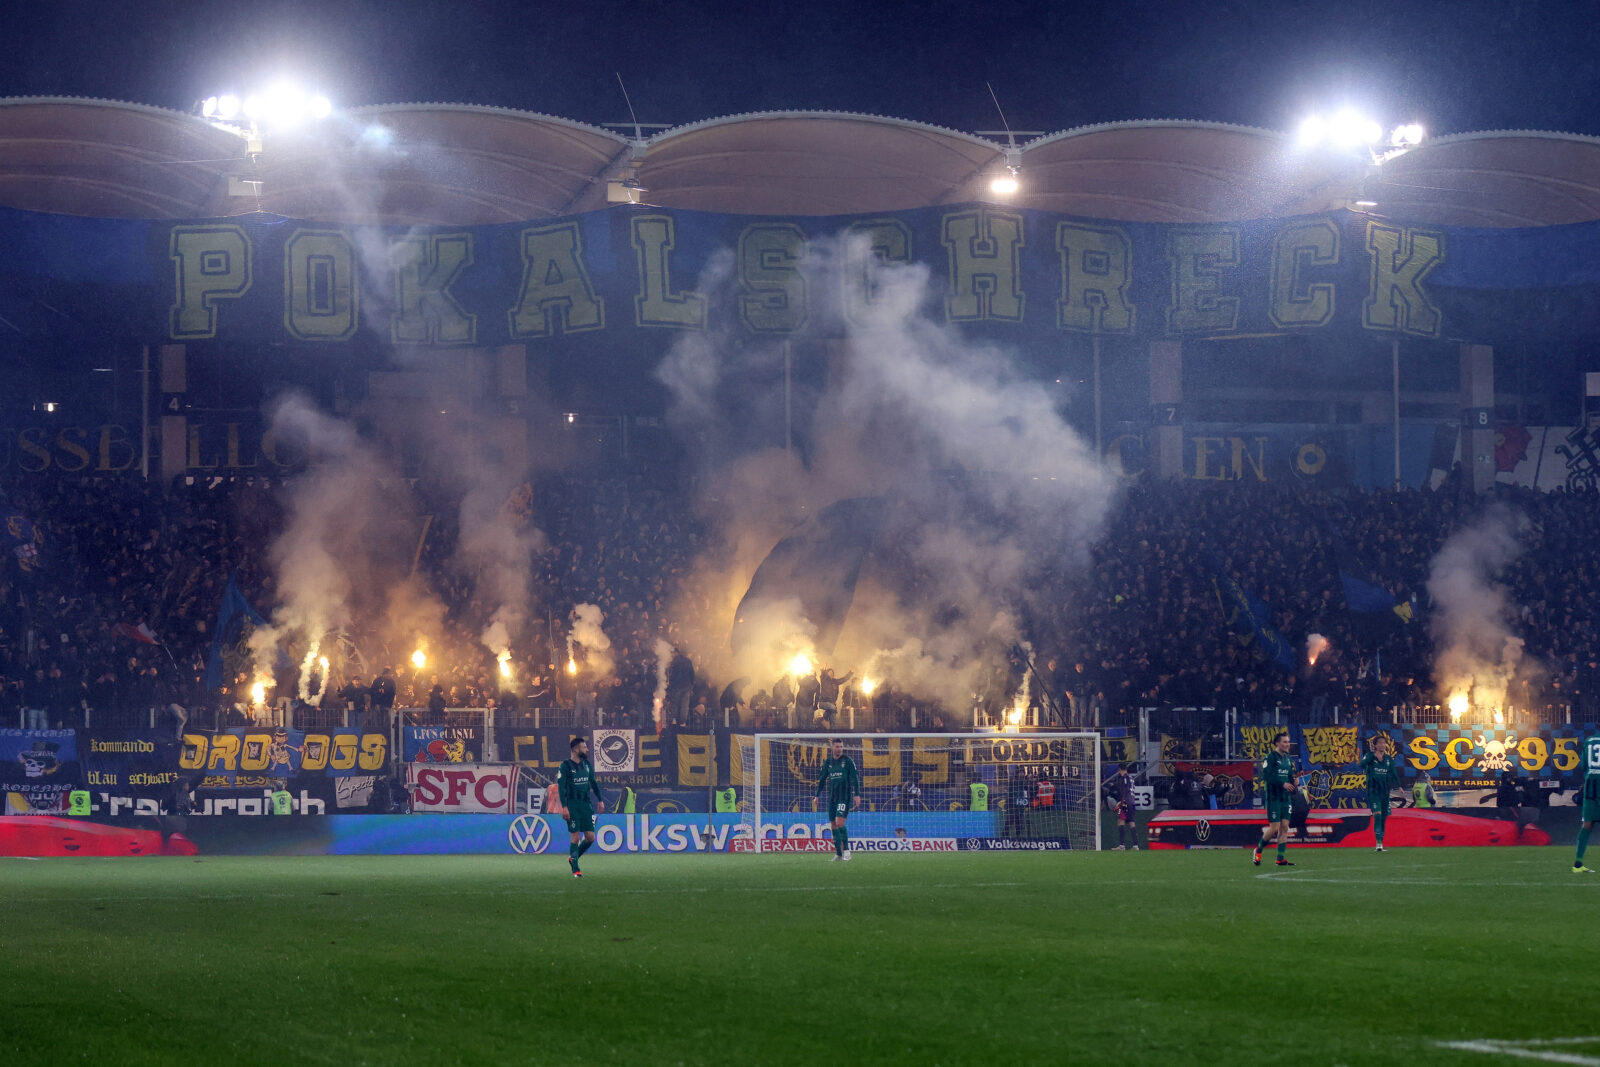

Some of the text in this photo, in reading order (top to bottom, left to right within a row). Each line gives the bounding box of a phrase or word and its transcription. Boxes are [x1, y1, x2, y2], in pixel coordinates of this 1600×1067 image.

[1479, 412, 1488, 425] 8
[1407, 736, 1581, 771] SC 95
[415, 769, 509, 808] SFC
[596, 813, 833, 852] olkswagen
[987, 839, 1060, 851] Volkswagen
